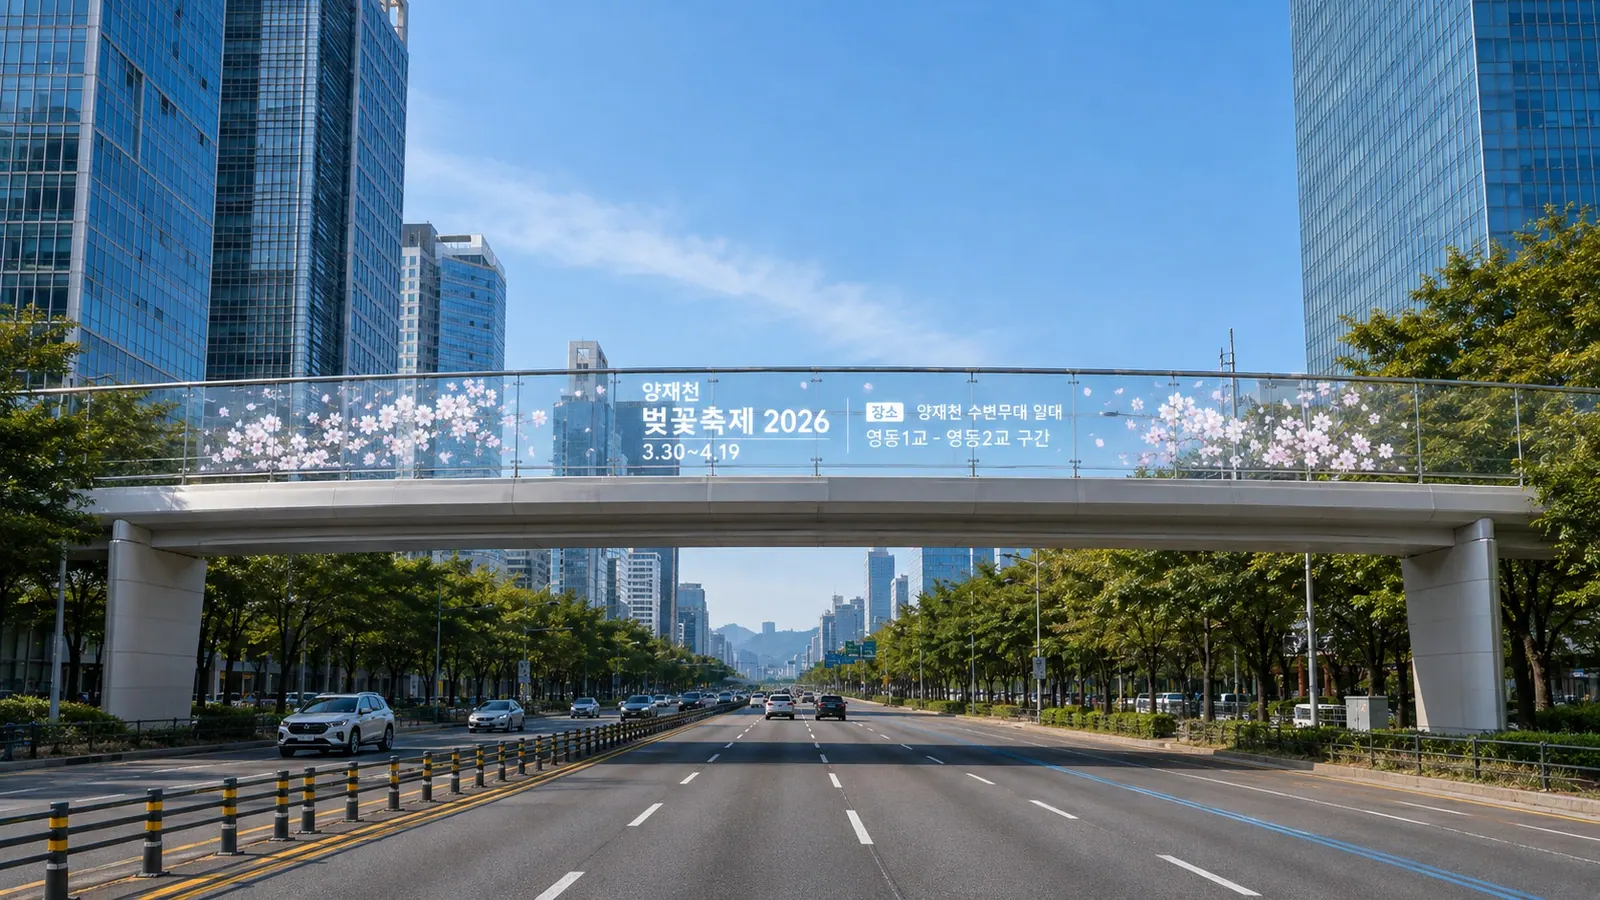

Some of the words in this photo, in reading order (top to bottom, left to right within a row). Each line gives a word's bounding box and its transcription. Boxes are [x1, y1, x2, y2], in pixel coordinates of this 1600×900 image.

[642, 381, 700, 402] 양재천
[642, 405, 754, 436] 벚꽃축제
[763, 408, 830, 434] 2026
[871, 404, 899, 420] 장소
[916, 403, 962, 421] 양재천
[967, 403, 1028, 421] 수변무대
[1033, 403, 1062, 421] 일대
[866, 428, 929, 448] 영동1교
[946, 428, 1012, 448] 영동2교
[1016, 428, 1051, 448] 구간
[642, 442, 741, 461] 3.30~4.19
